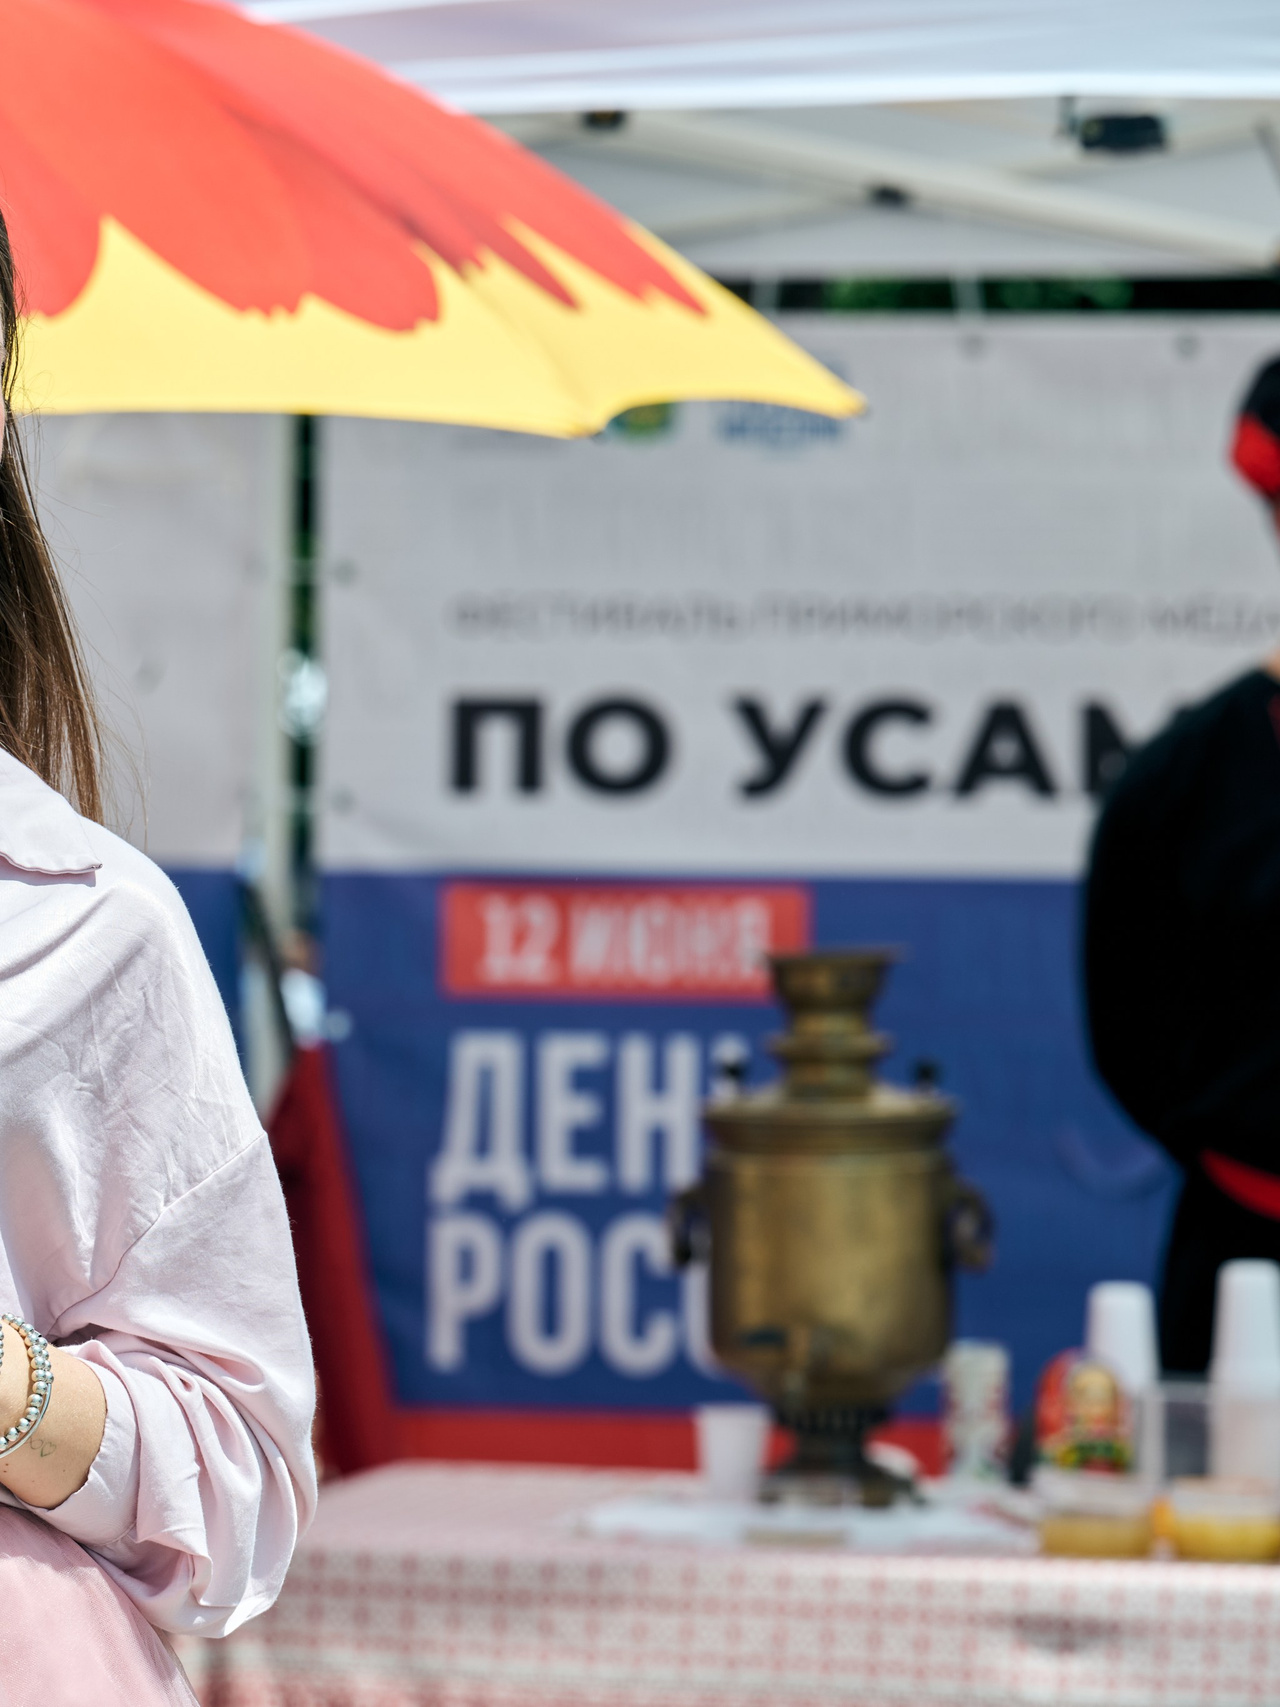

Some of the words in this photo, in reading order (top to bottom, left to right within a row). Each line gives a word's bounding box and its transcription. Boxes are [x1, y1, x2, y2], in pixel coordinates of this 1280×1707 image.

[448, 693, 674, 801] ПО
[481, 898, 556, 981] 12
[572, 899, 766, 981] ИЮНЯ
